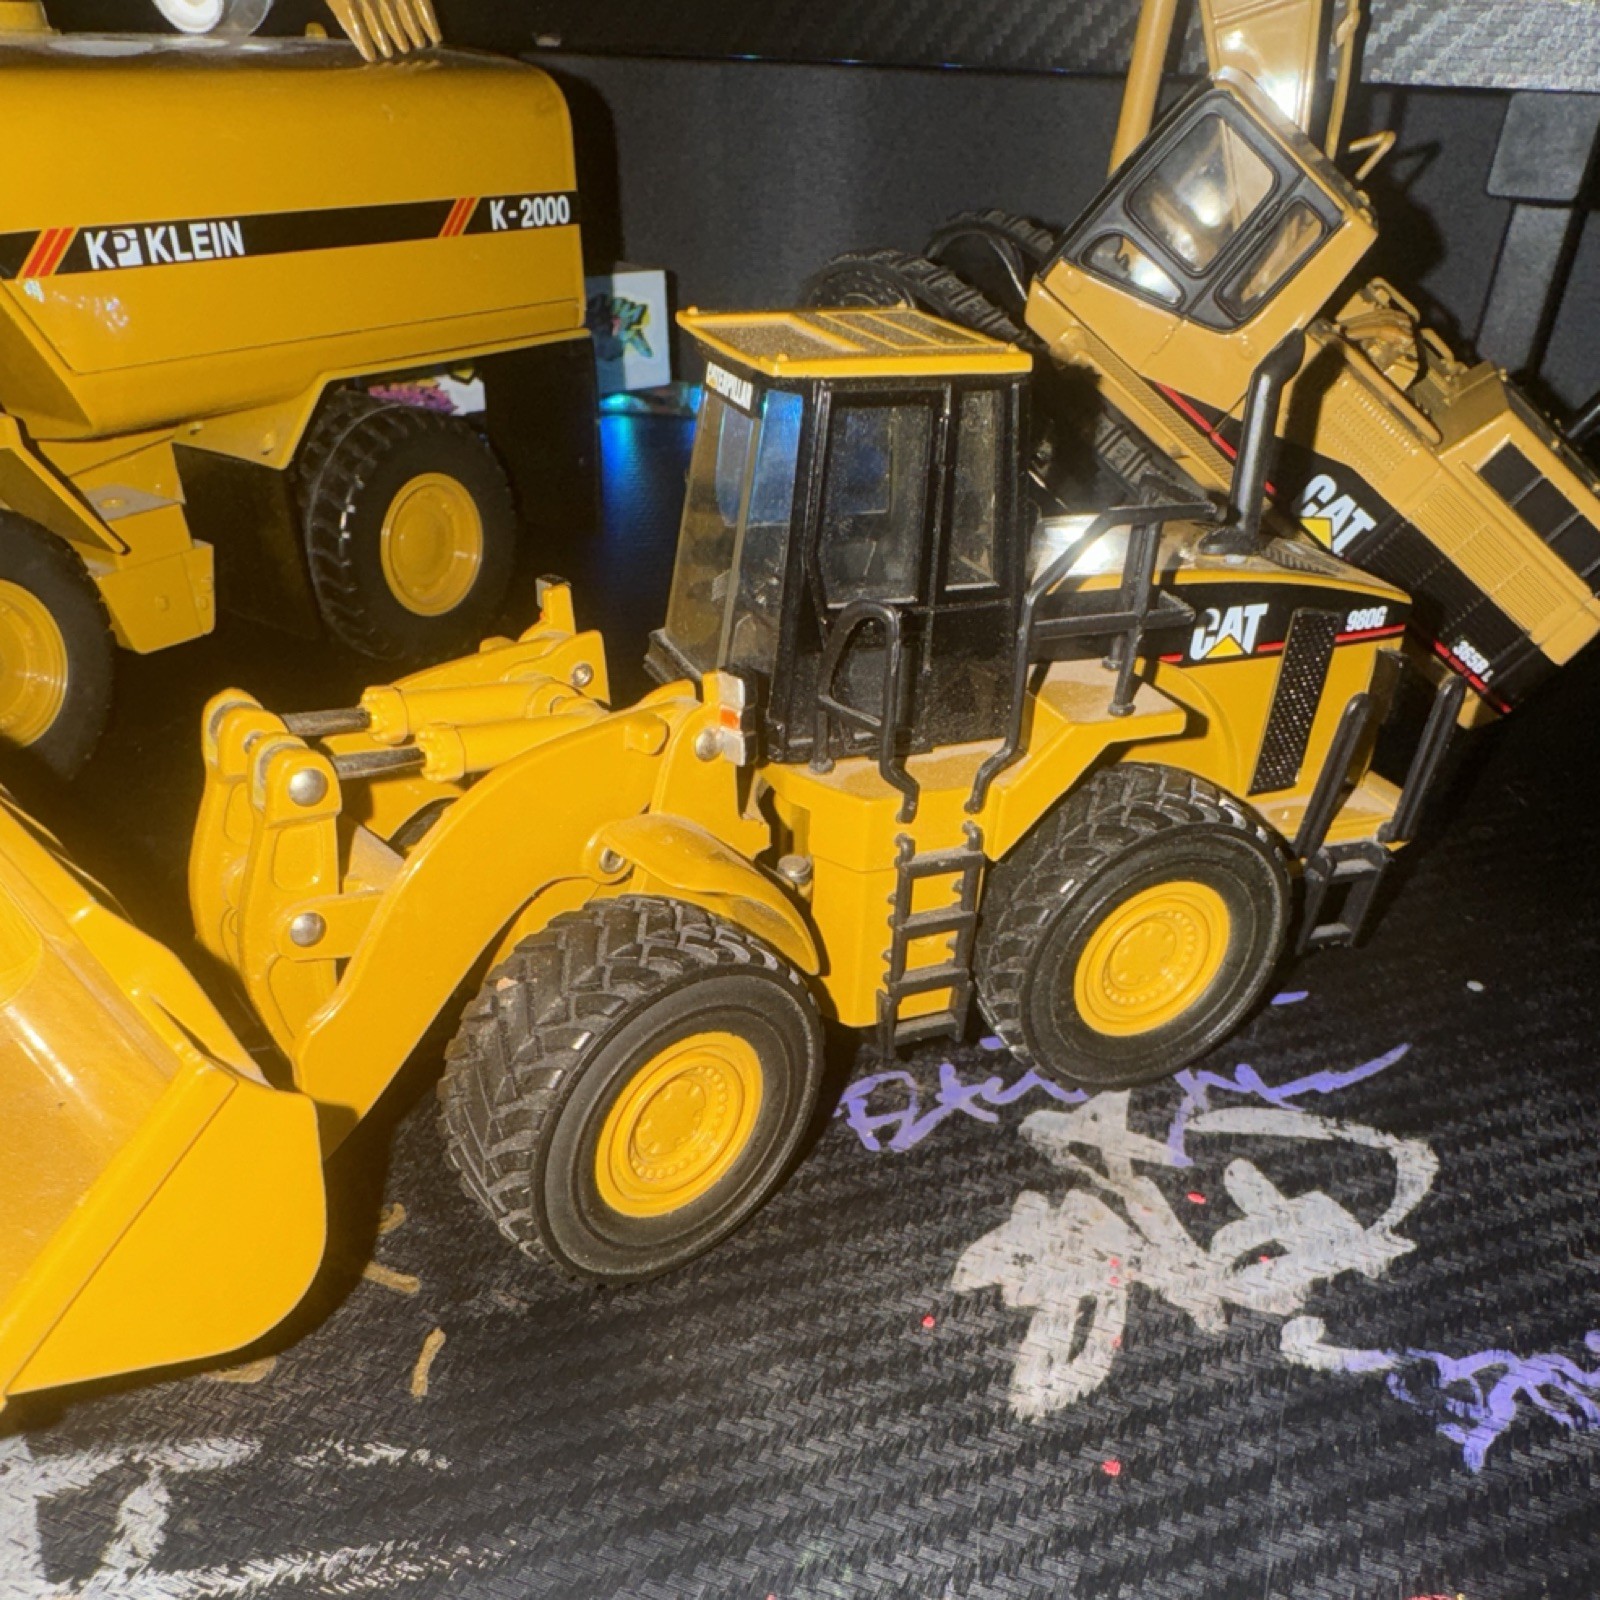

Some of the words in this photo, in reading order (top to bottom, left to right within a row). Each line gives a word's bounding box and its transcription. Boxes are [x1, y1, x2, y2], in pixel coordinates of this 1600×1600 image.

[144, 220, 245, 264] KLEIN
[1300, 473, 1377, 557] CAT
[1189, 602, 1270, 661] CAT
